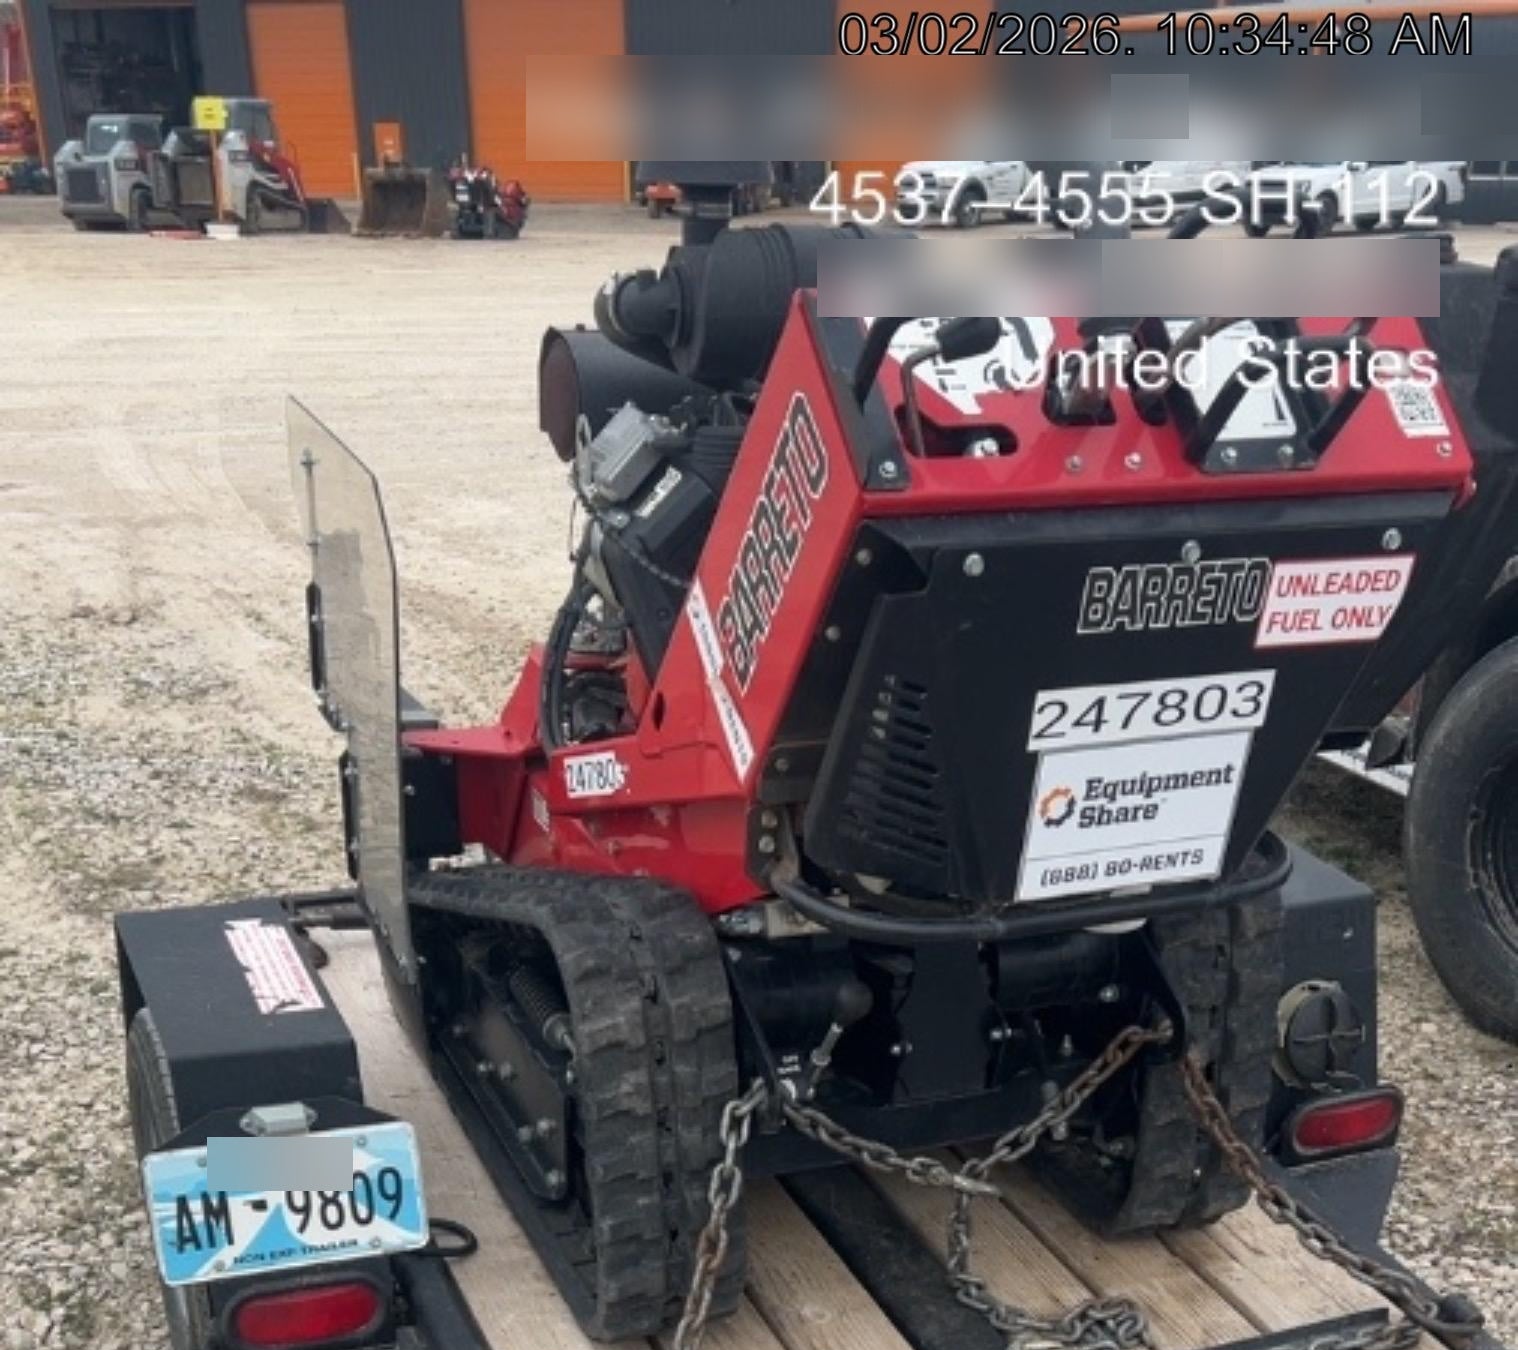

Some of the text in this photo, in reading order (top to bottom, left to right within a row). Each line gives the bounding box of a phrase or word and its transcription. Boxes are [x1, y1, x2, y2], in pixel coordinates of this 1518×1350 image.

[717, 391, 829, 697] BARRETO
[1076, 557, 1273, 635] BARRETO
[1276, 569, 1401, 599] UNLEADED
[1265, 604, 1394, 635] FUEL ONLY
[1031, 681, 1265, 740] 247803
[1082, 763, 1235, 803] Equipment
[1077, 802, 1160, 829] Share
